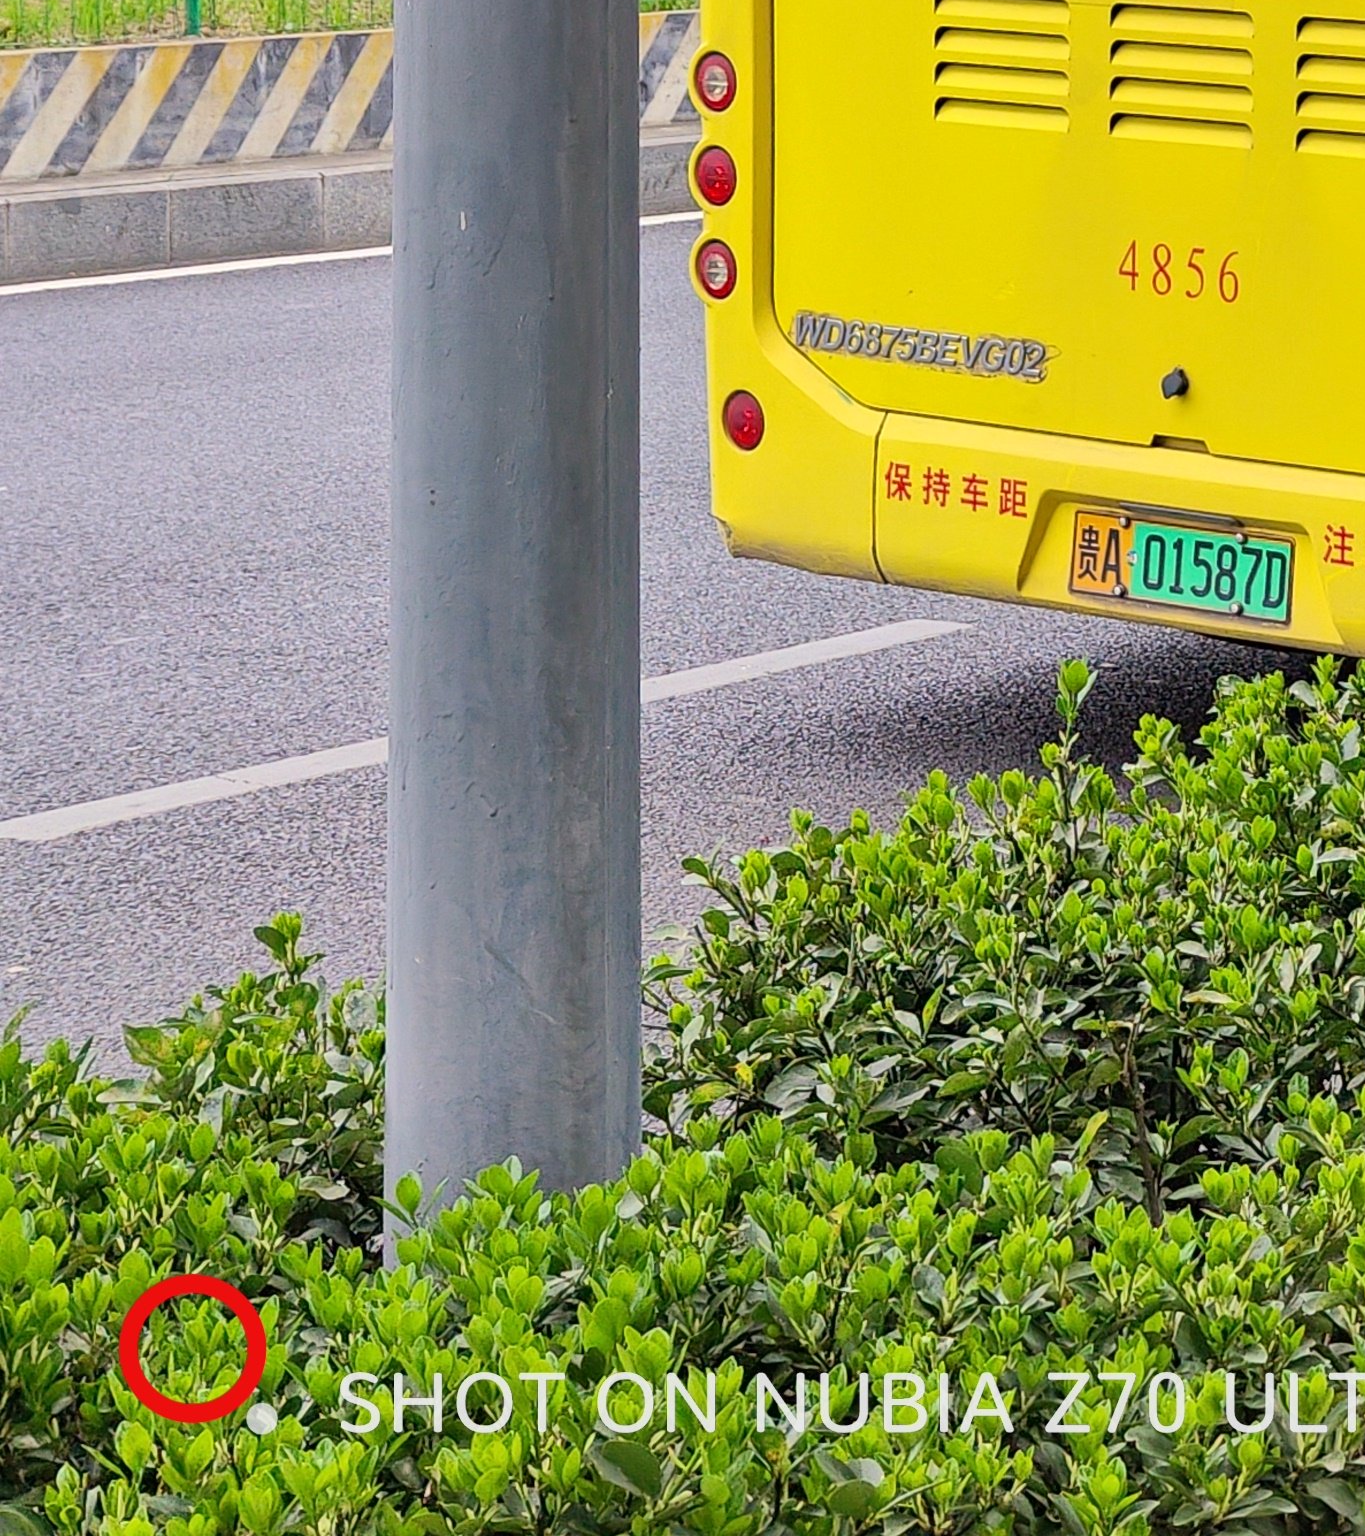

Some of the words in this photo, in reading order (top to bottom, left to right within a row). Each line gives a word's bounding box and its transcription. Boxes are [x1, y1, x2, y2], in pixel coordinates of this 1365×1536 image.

[1118, 239, 1240, 304] 4856
[794, 312, 1047, 378] WD6875BEVG02
[884, 461, 1029, 519] 保持车距
[1077, 524, 1123, 586] 贵A
[1141, 533, 1287, 609] 01587D
